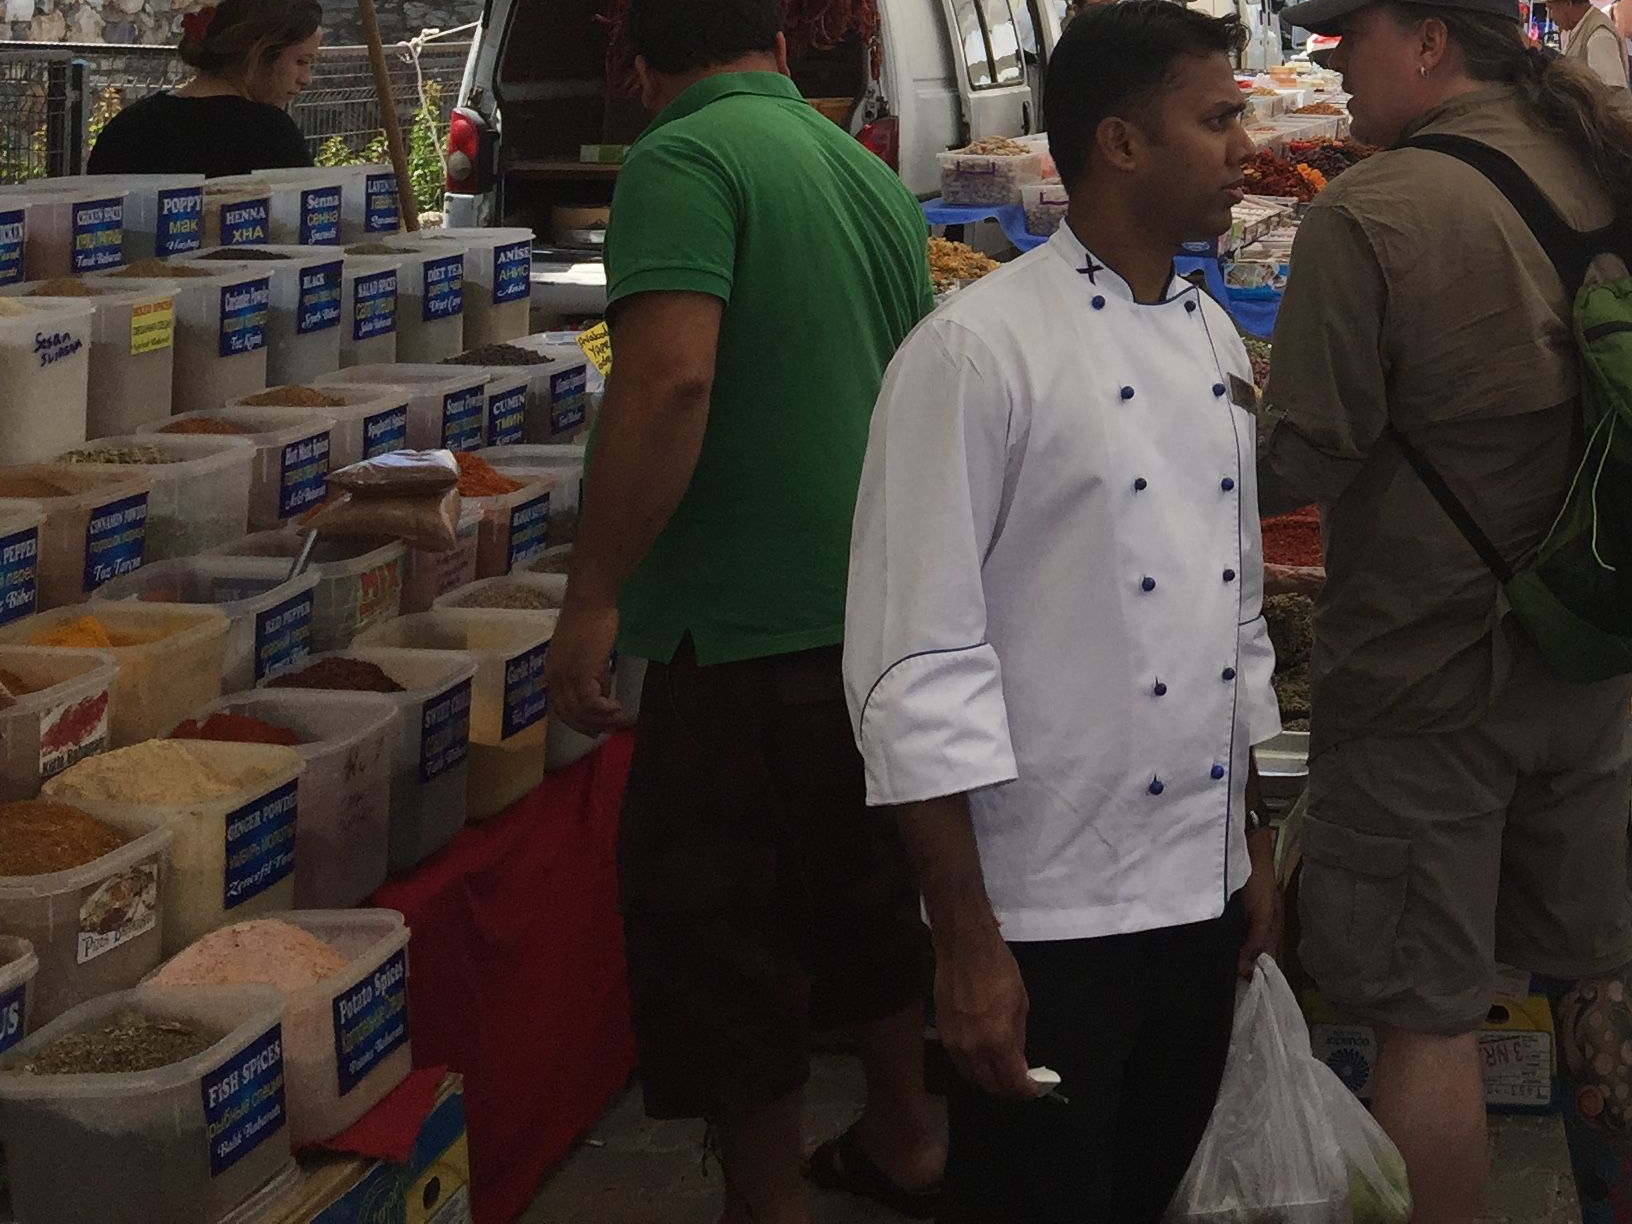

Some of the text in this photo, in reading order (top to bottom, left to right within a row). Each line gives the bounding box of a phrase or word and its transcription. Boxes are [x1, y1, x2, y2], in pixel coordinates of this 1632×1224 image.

[163, 195, 201, 215] POPPY
[307, 193, 340, 209] Senna
[226, 207, 267, 225] HENNA
